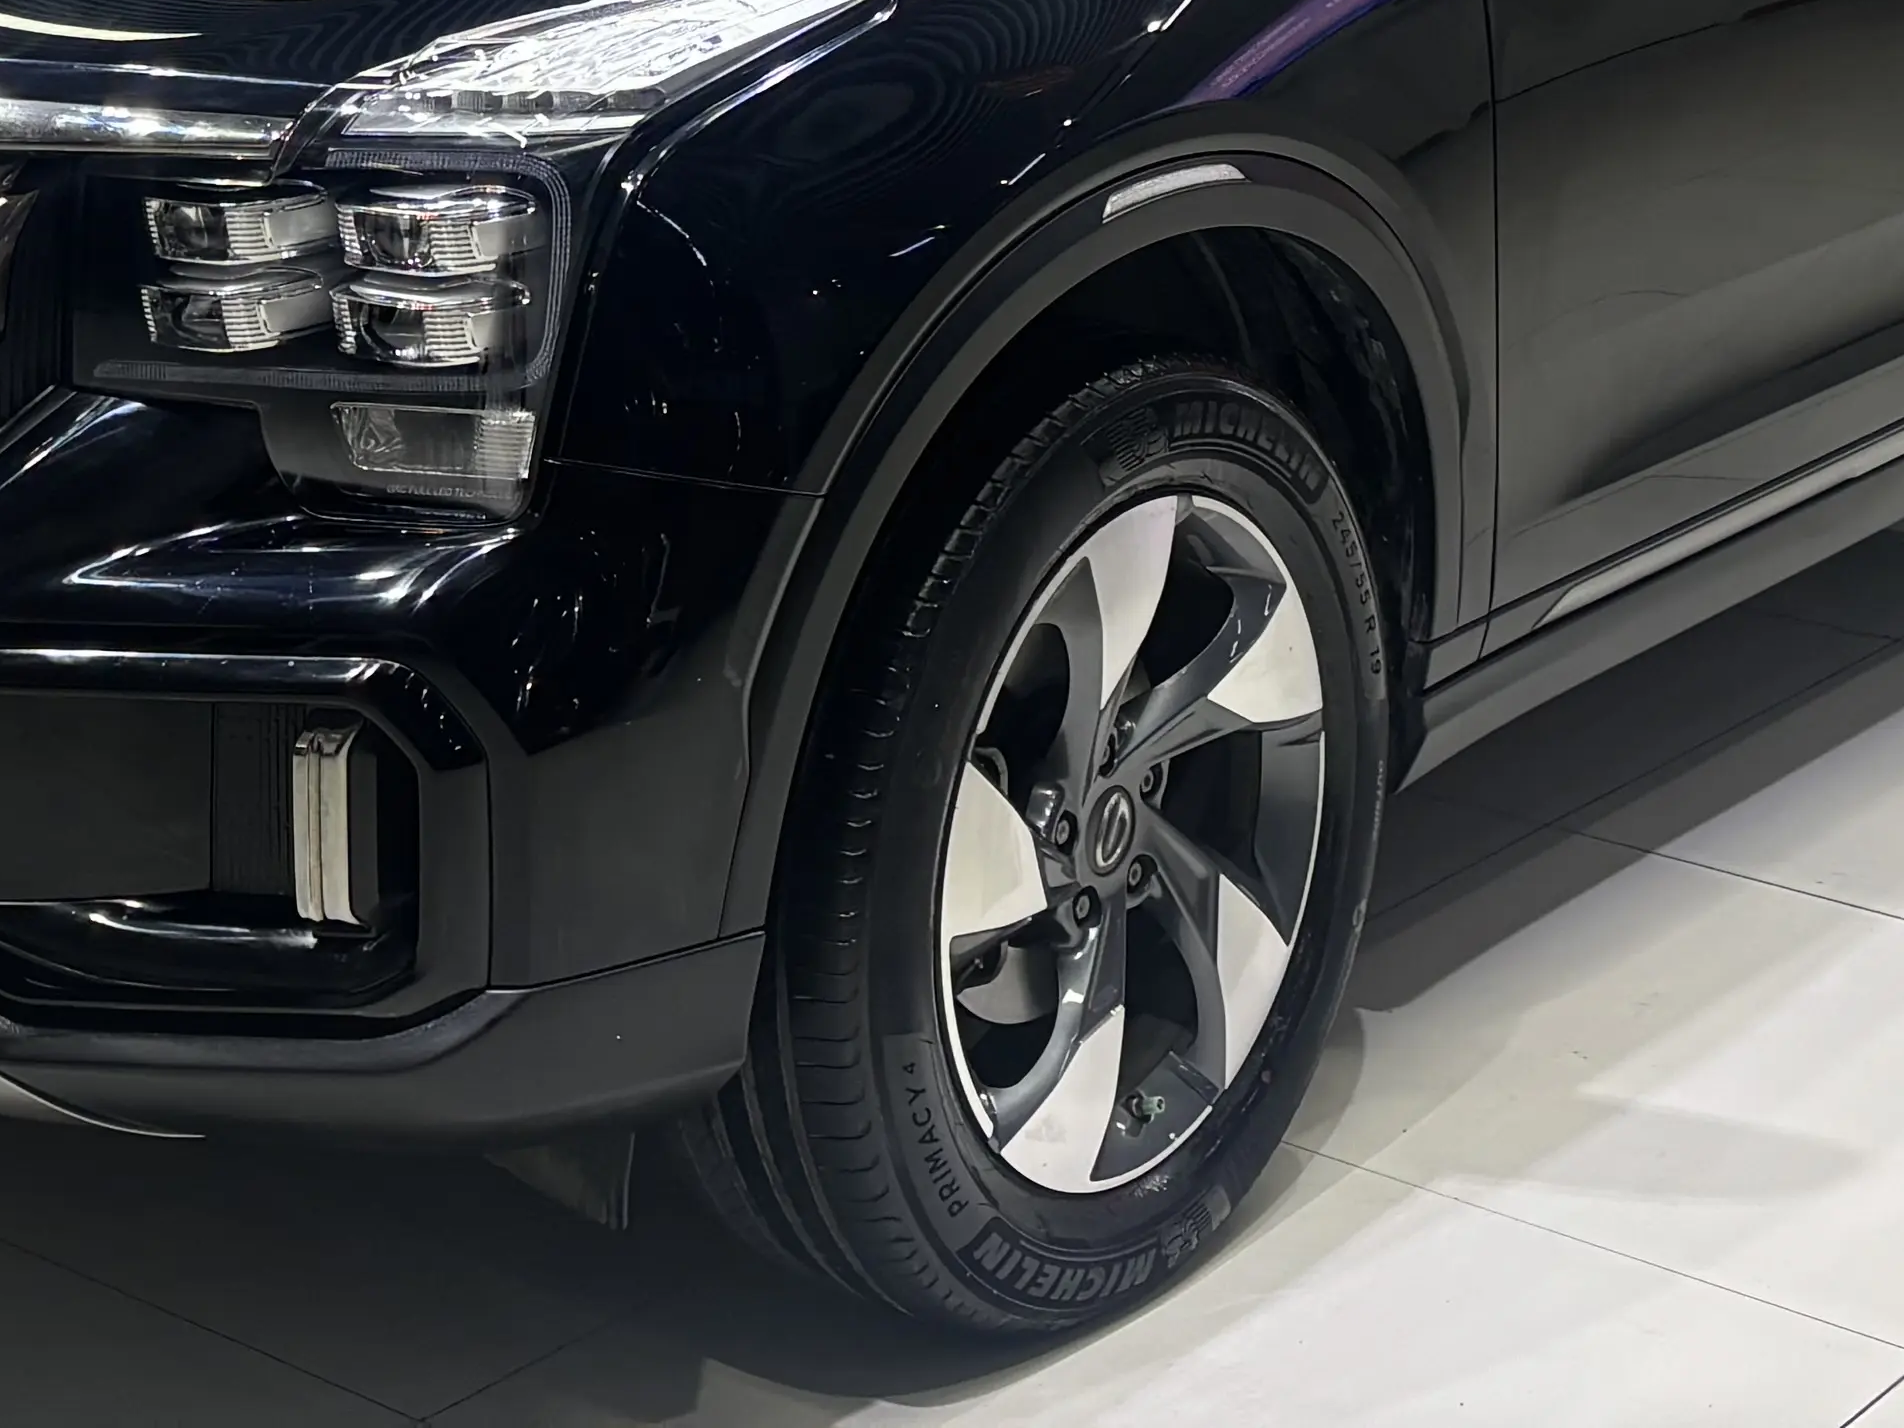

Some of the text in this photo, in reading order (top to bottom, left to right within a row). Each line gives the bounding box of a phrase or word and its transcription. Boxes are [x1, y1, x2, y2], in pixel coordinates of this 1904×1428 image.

[1174, 400, 1329, 492] MICHELIN
[1331, 511, 1382, 676] 245/55 R 19
[902, 1061, 969, 1219] PRIMACY 4
[973, 1231, 1157, 1302] MICHELIN
